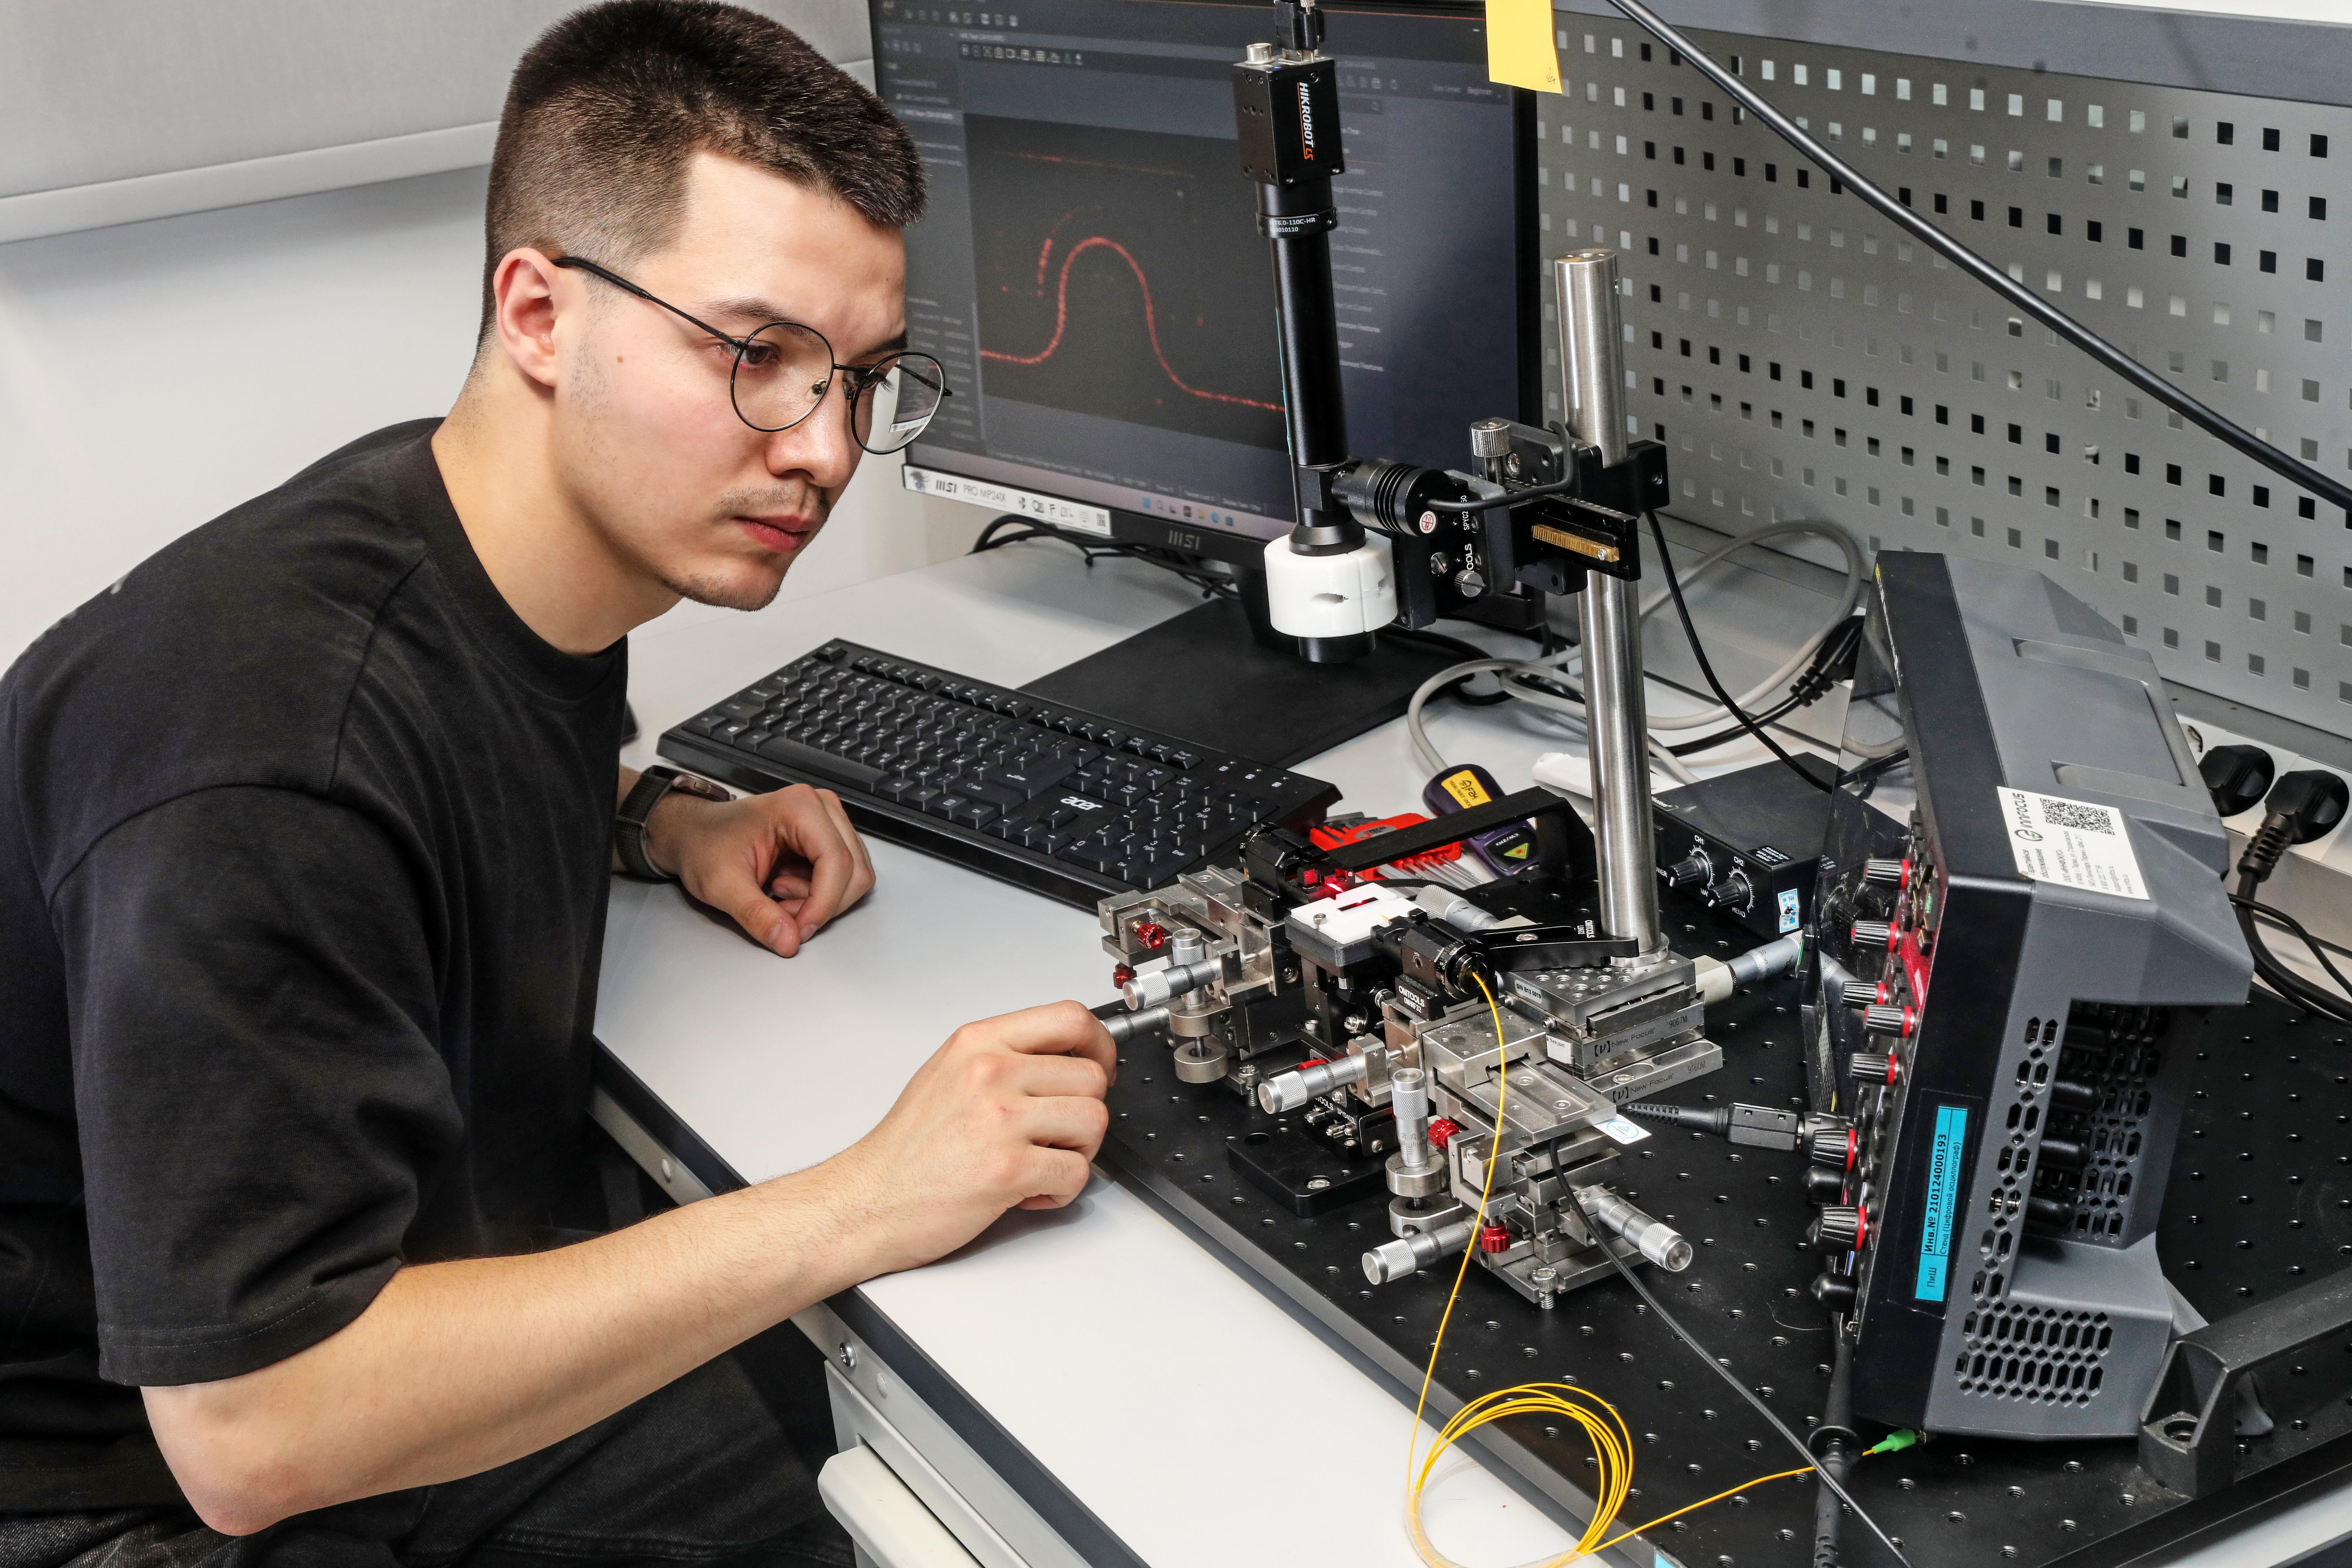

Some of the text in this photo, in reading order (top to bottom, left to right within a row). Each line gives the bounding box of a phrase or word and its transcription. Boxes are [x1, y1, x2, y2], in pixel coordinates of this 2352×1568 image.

[1299, 82, 1315, 147] HIKROBOT
[963, 485, 978, 496] PRO
[1061, 796, 1102, 810] acer
[1457, 789, 1465, 798] FAULT
[1463, 798, 1473, 807] LOCAT
[1695, 835, 1704, 845] CH1
[1734, 856, 1744, 867] CH2
[1584, 920, 1595, 938] OMTOOLS
[1398, 985, 1425, 1007] OMTOOLS
[1532, 991, 1541, 999] 5019
[1404, 997, 1422, 1013] OMHRF32
[1612, 1038, 1628, 1047] New
[1669, 1015, 1688, 1028] 9067M
[1550, 1037, 1565, 1048] Newport
[1630, 1085, 1647, 1094] New
[1688, 1061, 1705, 1074] 9160M
[1924, 1133, 1947, 1252] Инв.№ 210124000193
[1940, 1142, 1961, 1254] Стенд (Цифровой осциллограф)
[1927, 1267, 1937, 1287] ПиШ
